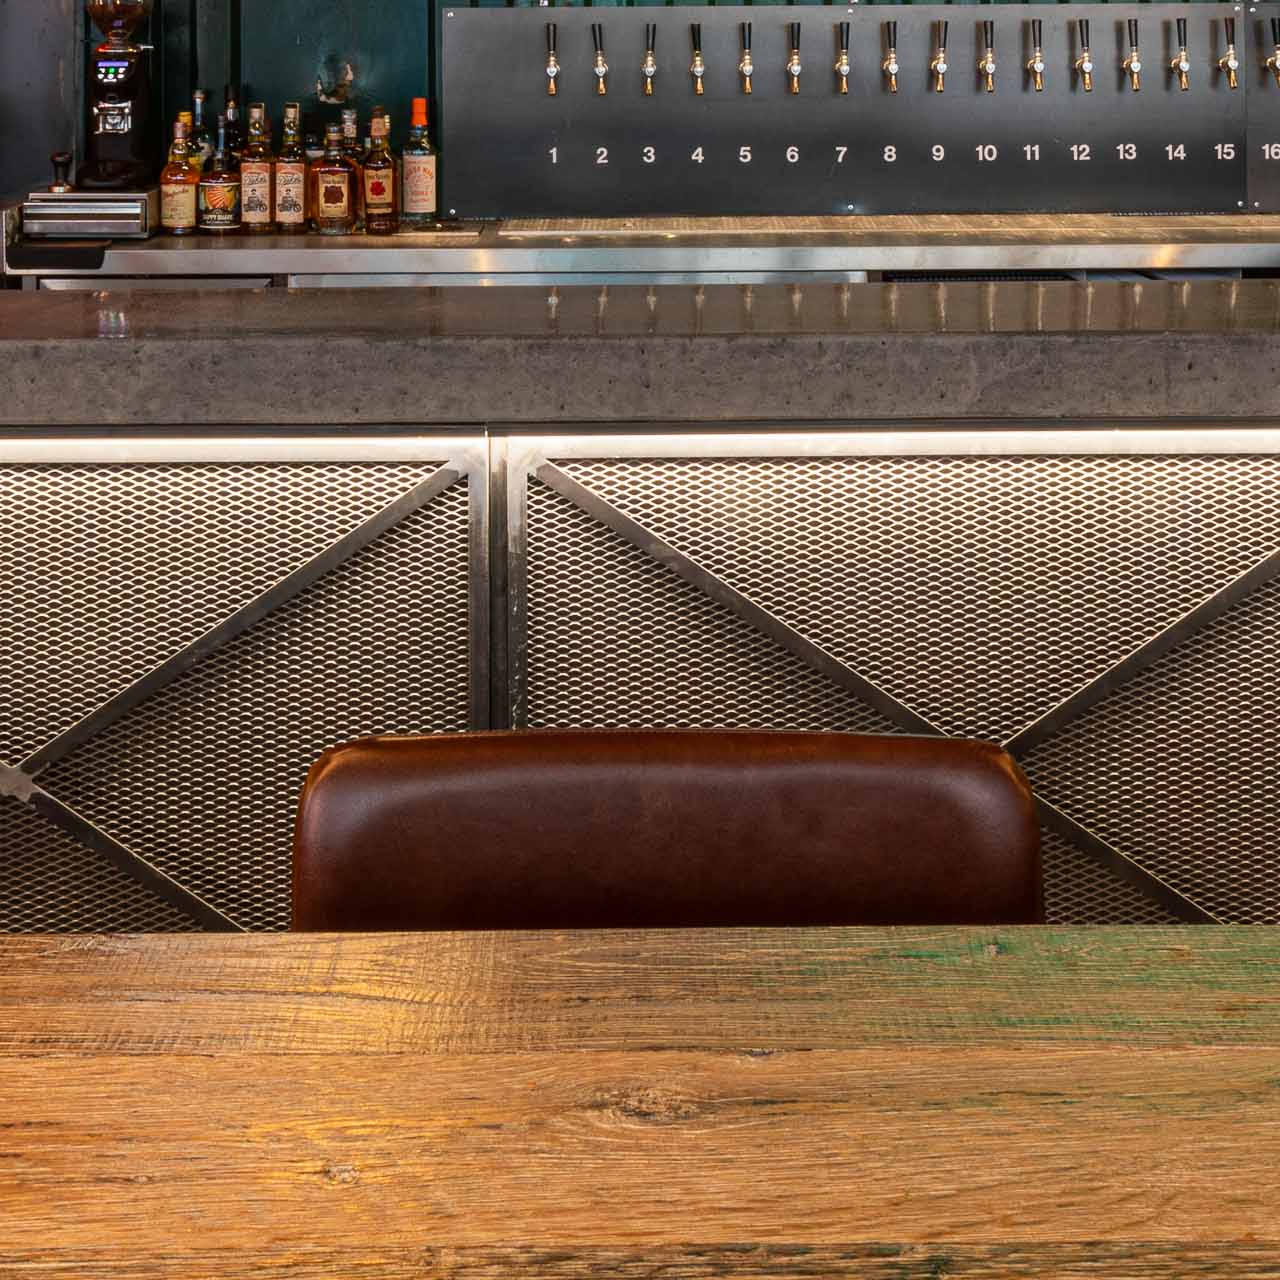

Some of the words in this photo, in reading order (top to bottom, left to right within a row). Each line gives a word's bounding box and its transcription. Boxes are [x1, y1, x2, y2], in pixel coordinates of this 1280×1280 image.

[549, 147, 557, 163] 1
[884, 146, 896, 162] 8
[1116, 144, 1136, 159] 13
